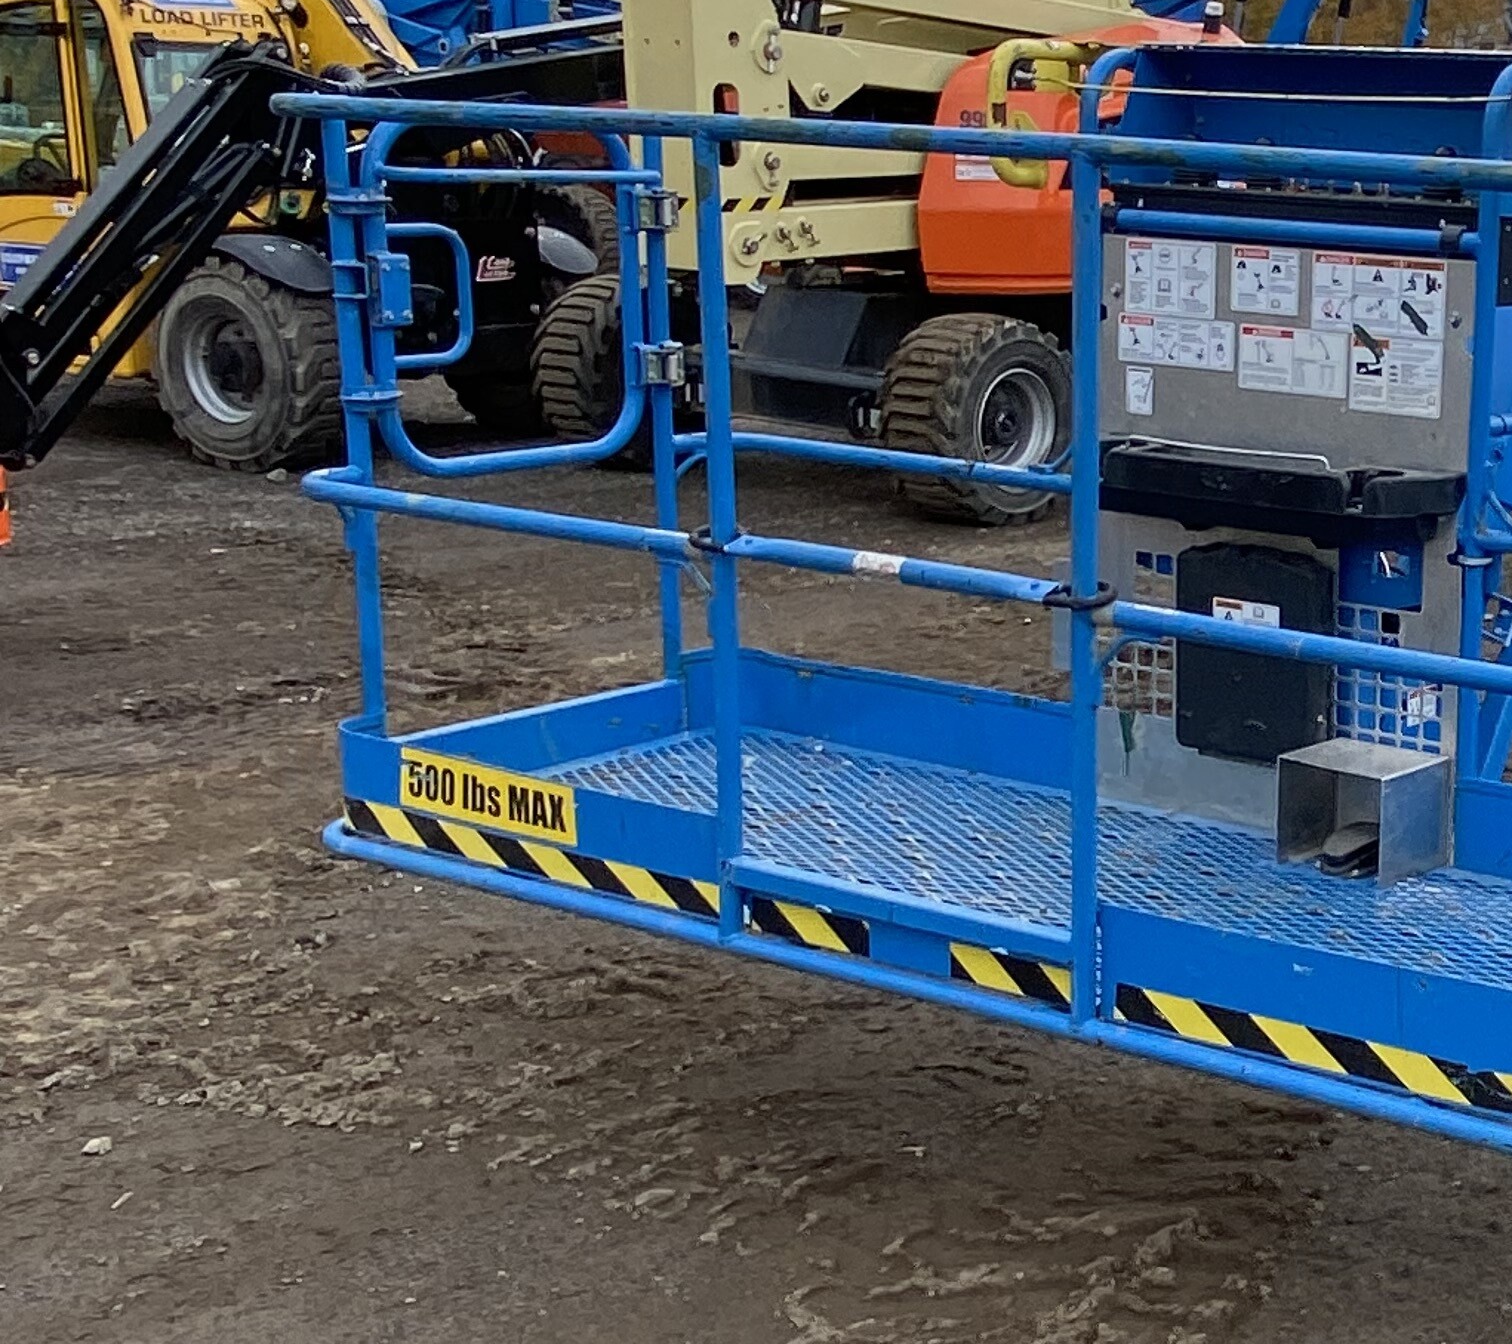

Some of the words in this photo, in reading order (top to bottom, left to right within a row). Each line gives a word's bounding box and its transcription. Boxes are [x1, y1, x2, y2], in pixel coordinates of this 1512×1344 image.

[140, 8, 194, 26] LOAD
[201, 11, 265, 29] LIFTER
[408, 760, 455, 806] 500
[462, 773, 501, 818] lbs
[508, 784, 567, 833] MAX
